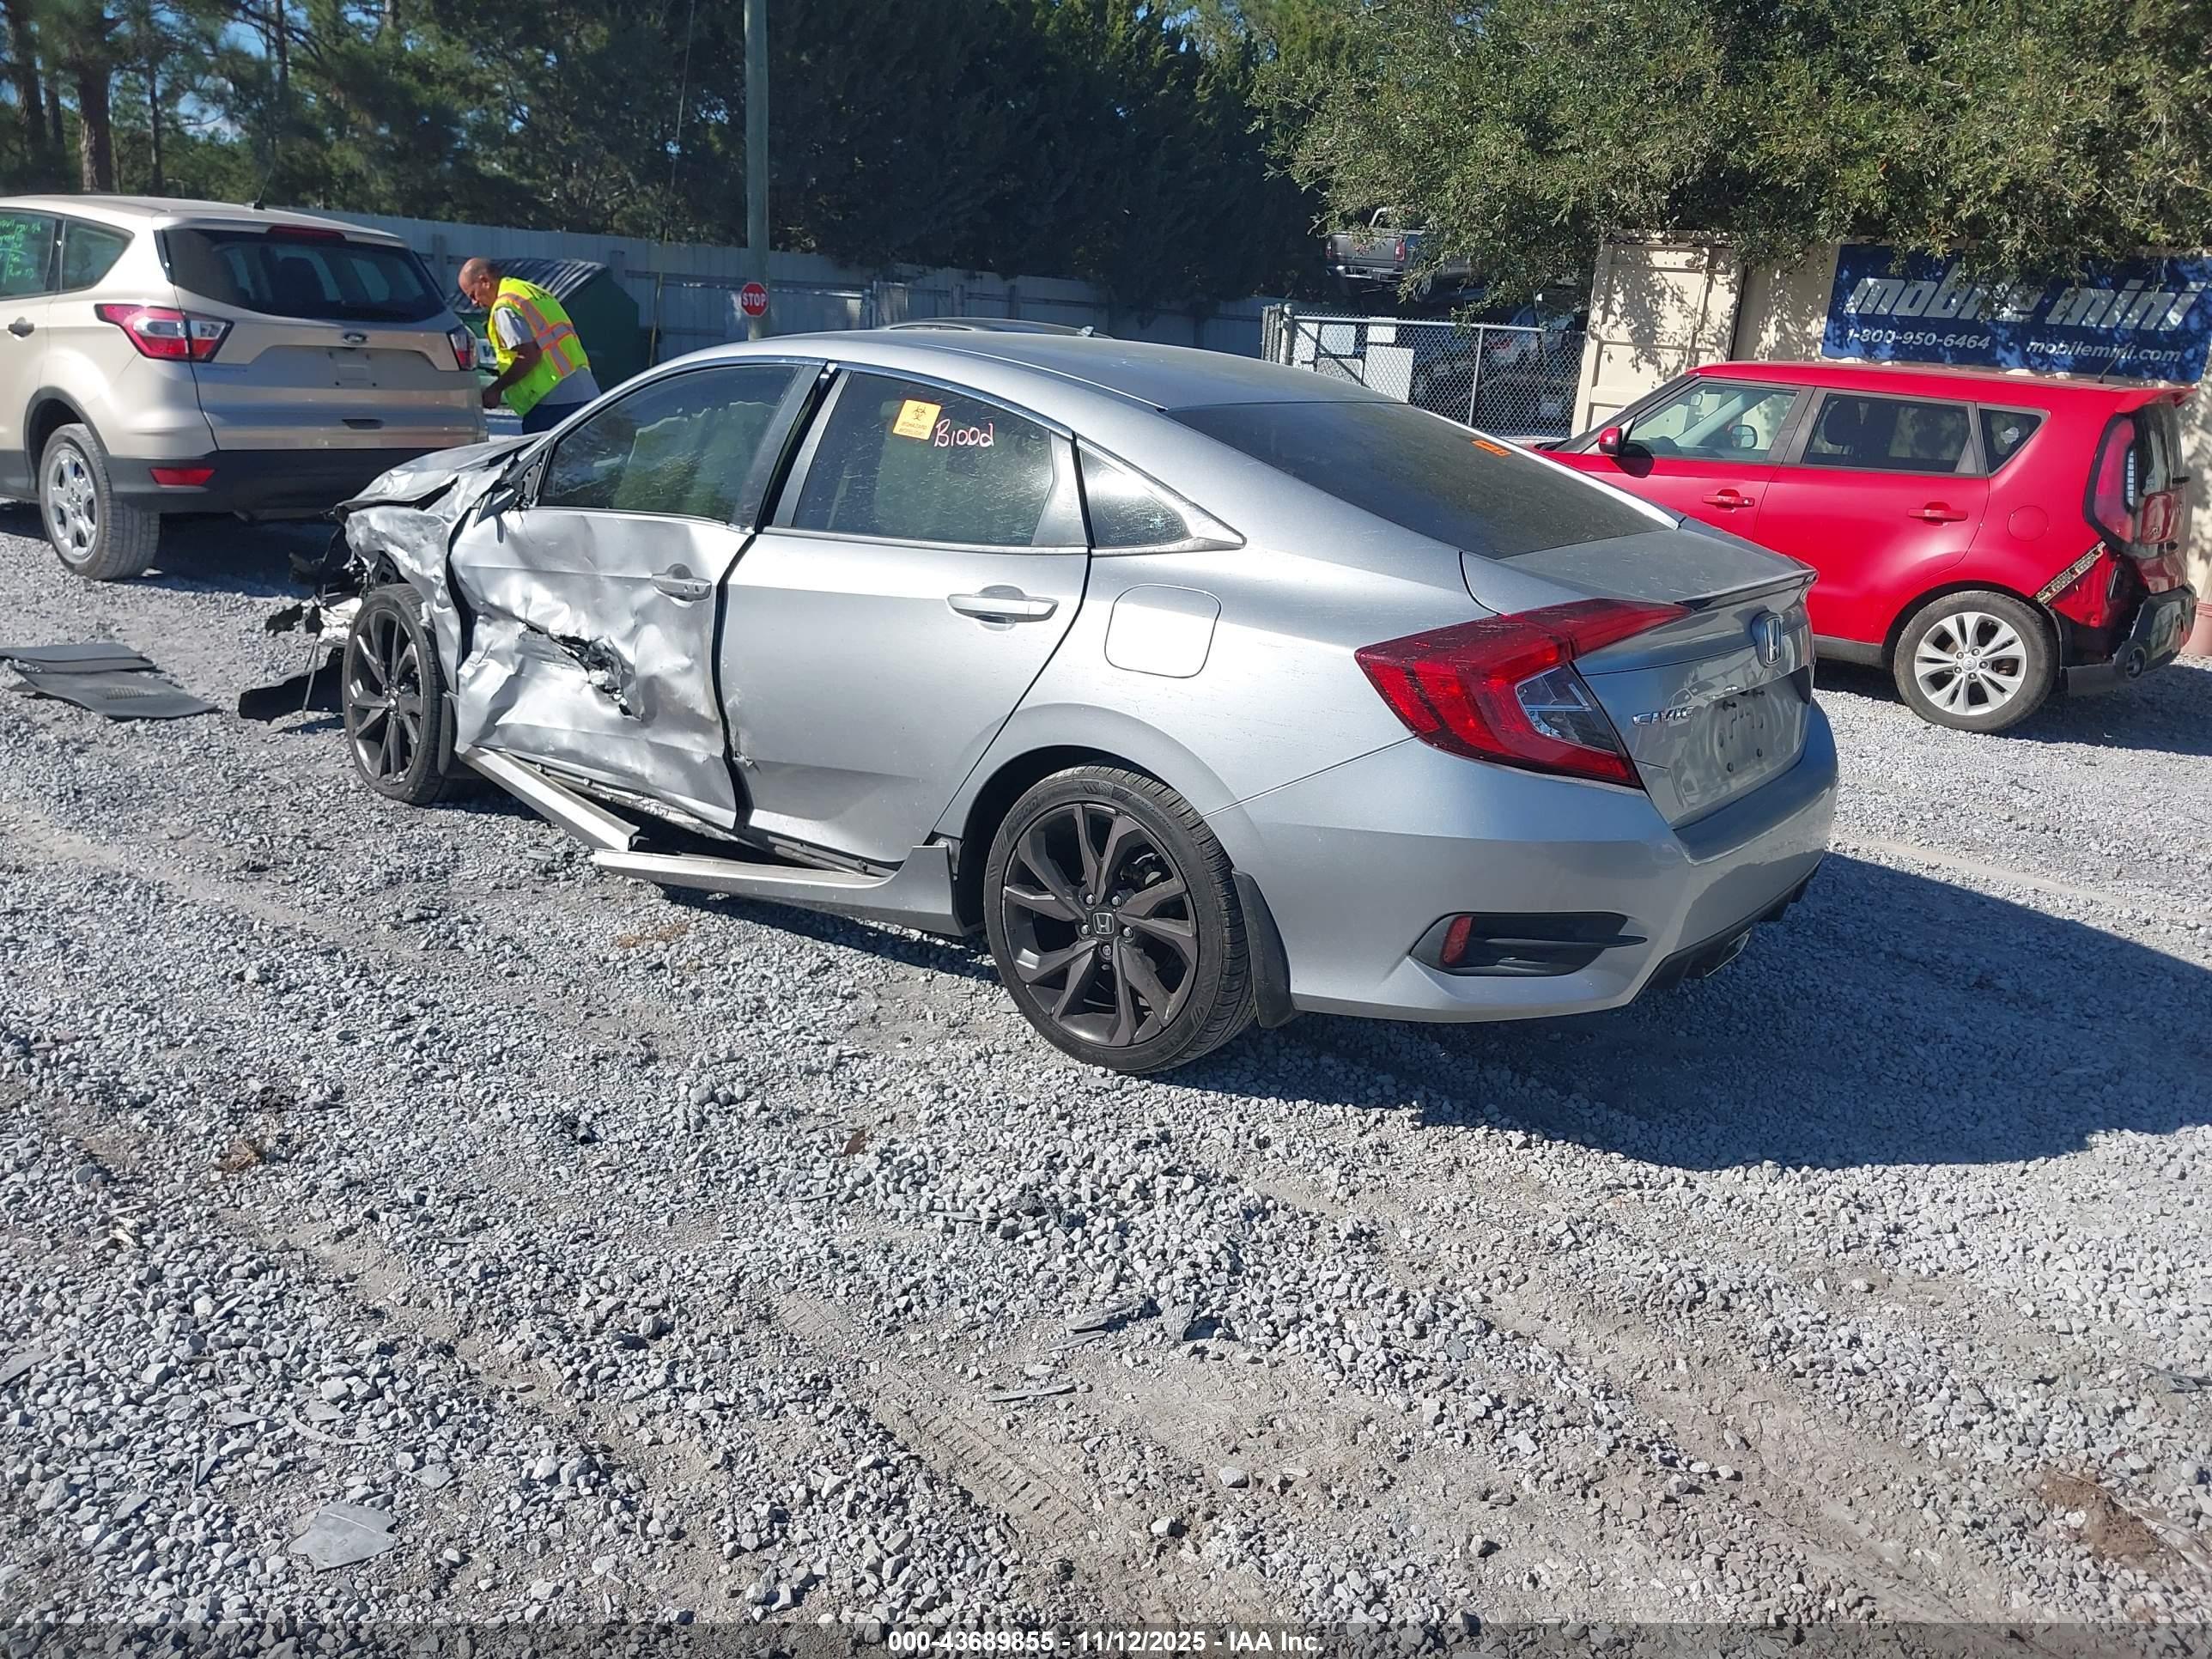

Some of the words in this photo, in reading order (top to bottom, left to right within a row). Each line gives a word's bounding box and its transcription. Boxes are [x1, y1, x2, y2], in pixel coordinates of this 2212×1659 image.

[742, 292, 767, 307] STOP
[2045, 278, 2208, 331] mini
[1846, 327, 1992, 349] 1-800-950-6464
[2026, 339, 2182, 362] mobilemini.com
[1632, 706, 1694, 726] CIVIC
